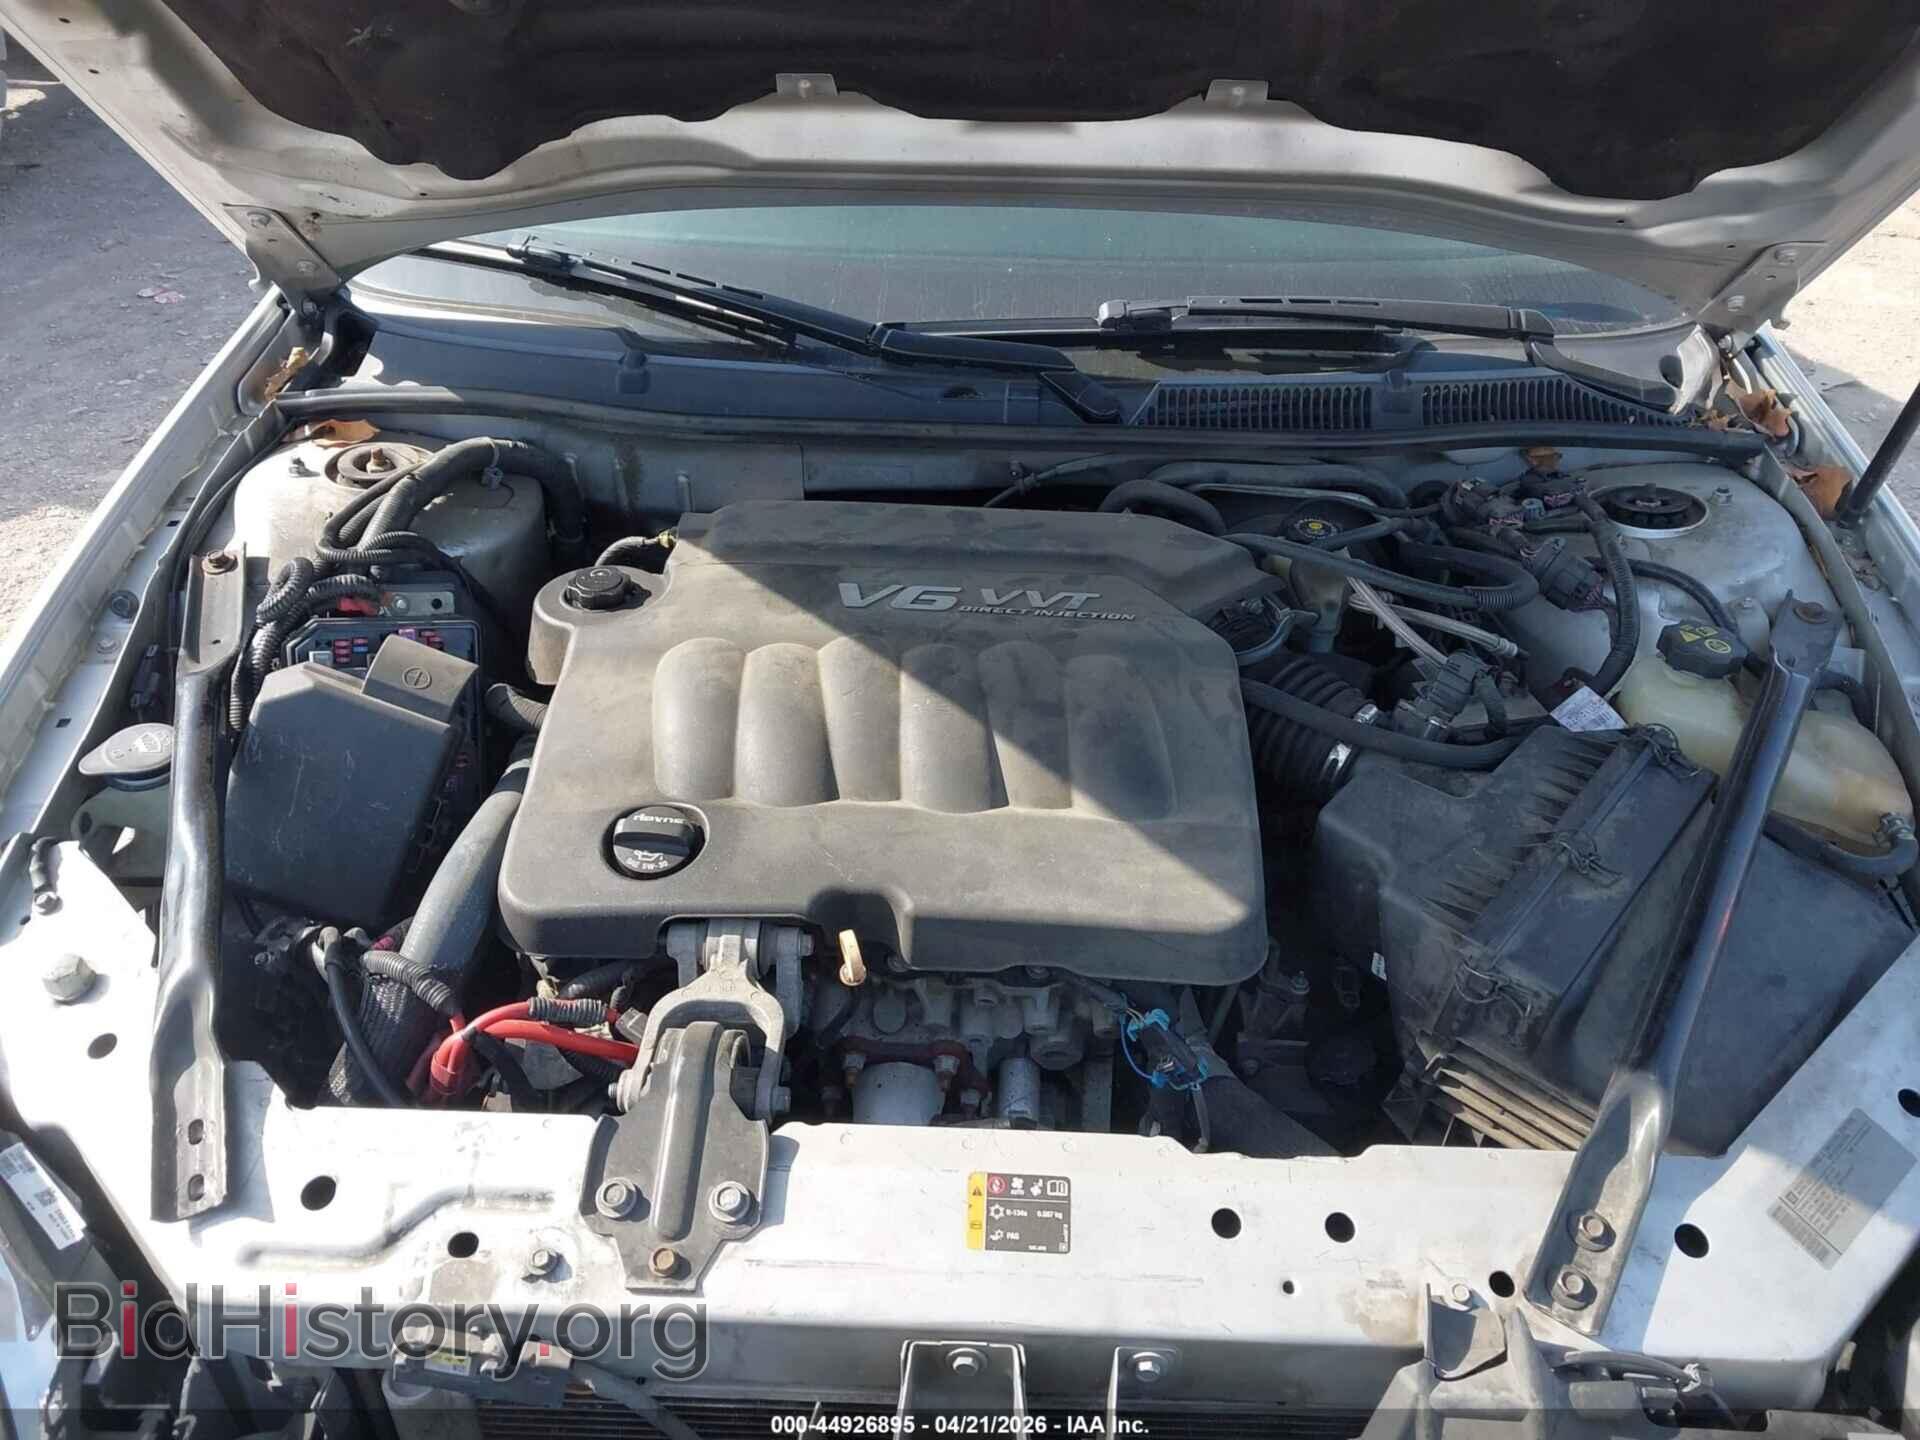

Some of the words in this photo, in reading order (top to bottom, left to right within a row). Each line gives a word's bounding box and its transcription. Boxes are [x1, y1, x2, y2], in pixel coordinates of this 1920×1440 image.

[838, 583, 962, 611] V6
[980, 588, 1101, 610] VVT
[959, 605, 1032, 616] DIRECT
[1033, 609, 1136, 621] INJECTION
